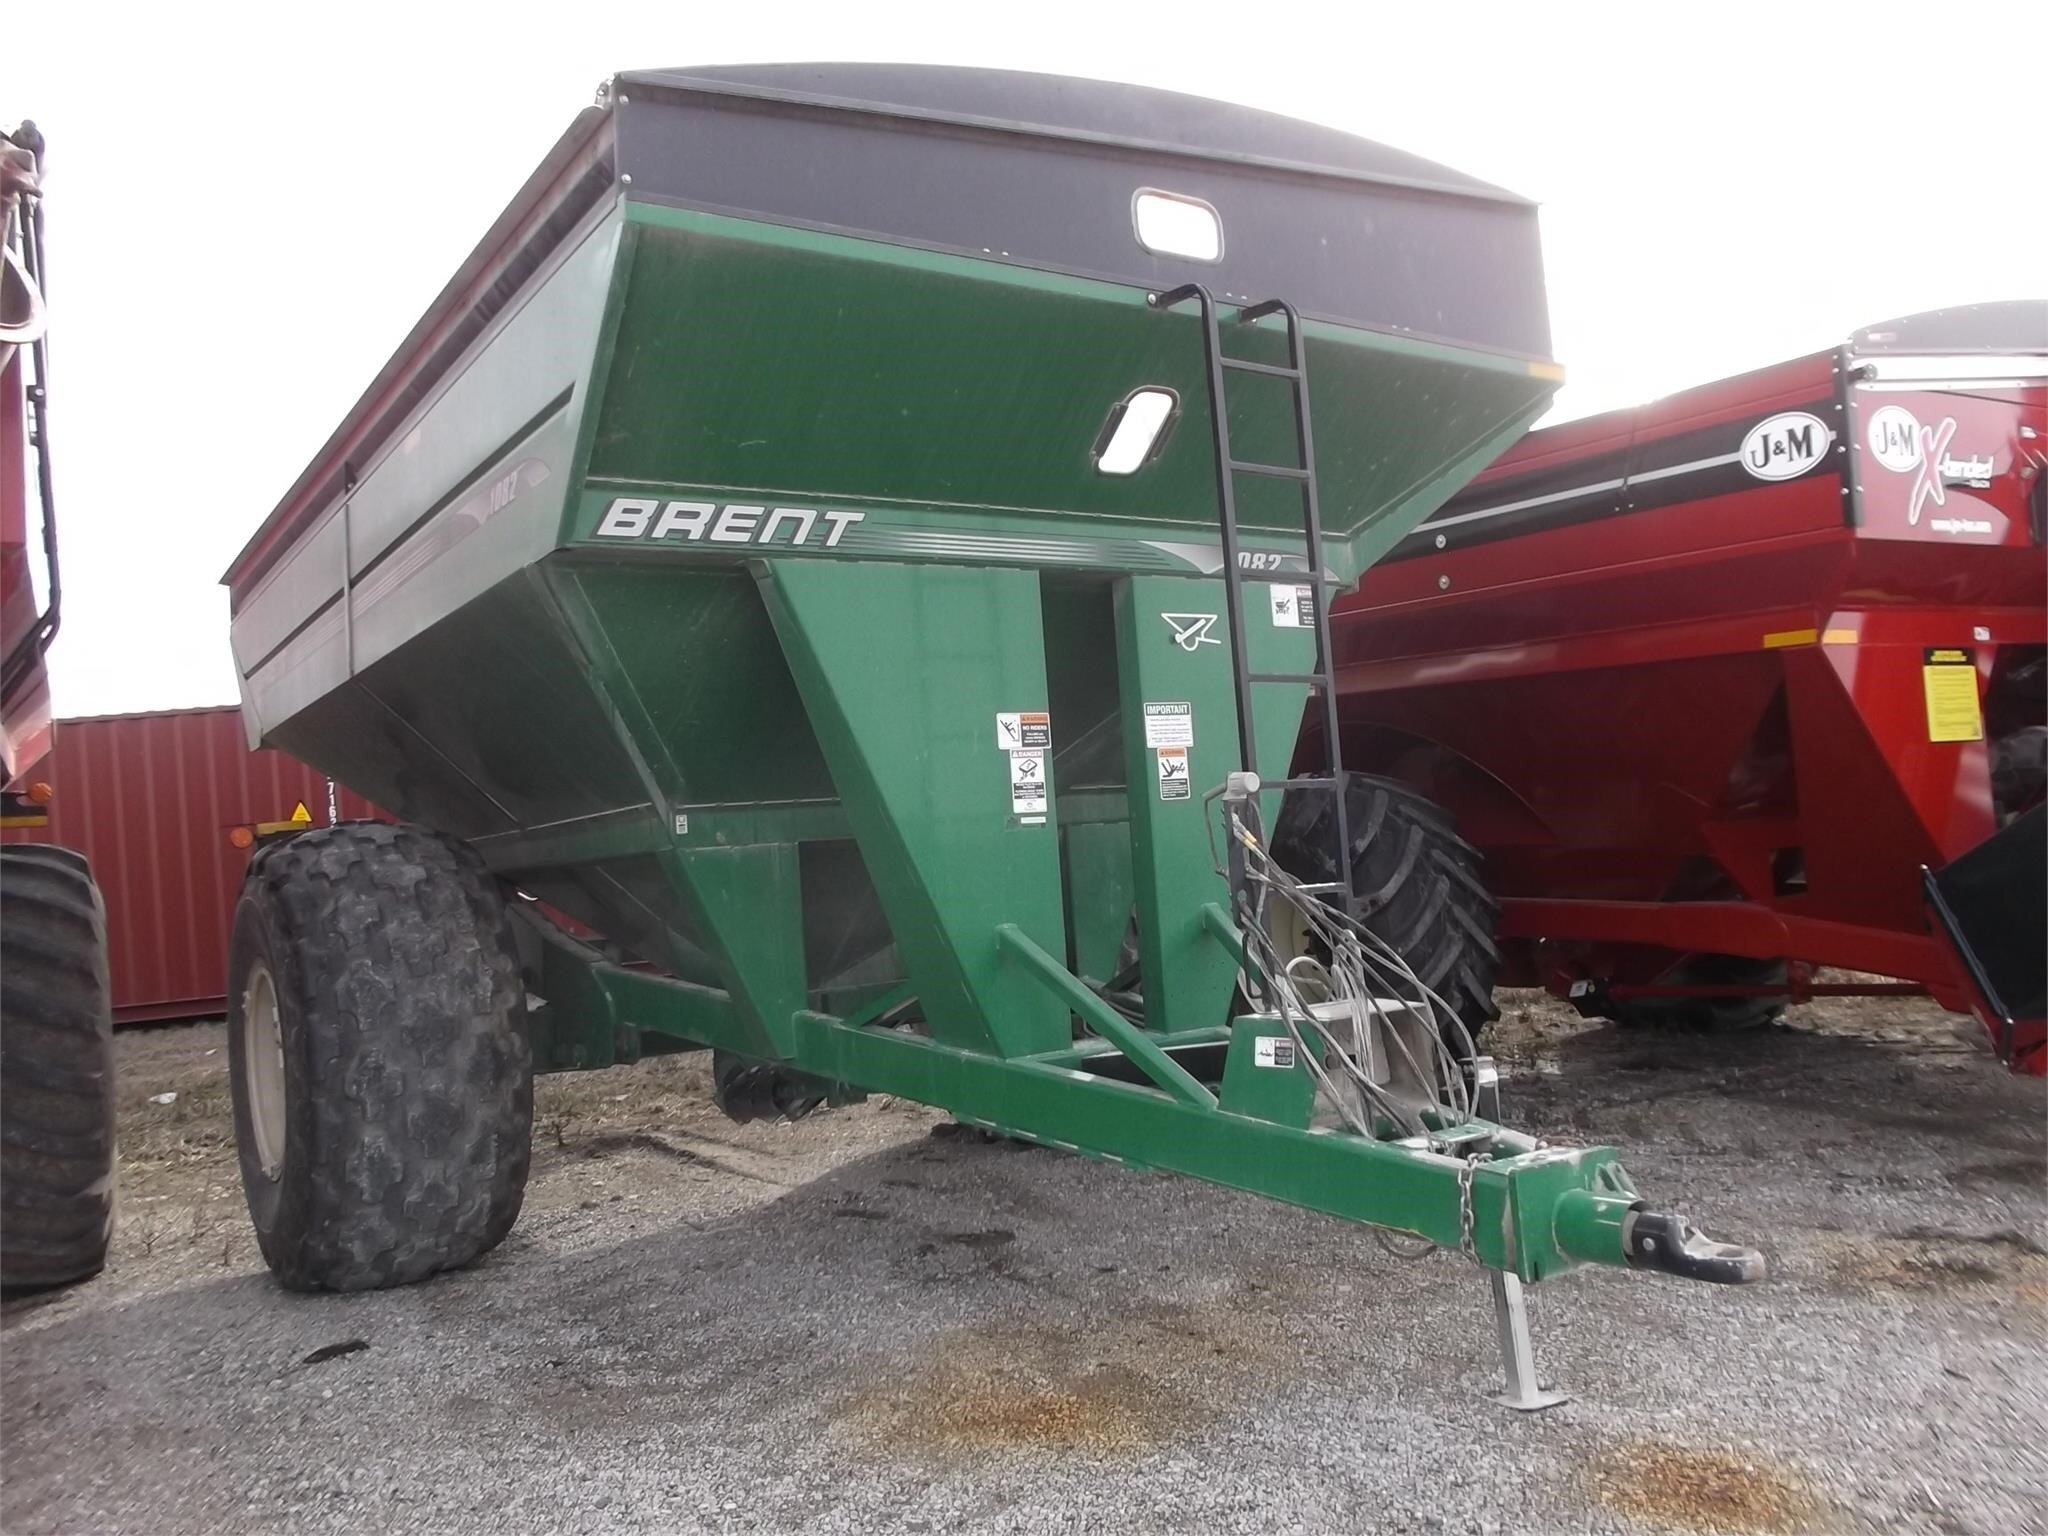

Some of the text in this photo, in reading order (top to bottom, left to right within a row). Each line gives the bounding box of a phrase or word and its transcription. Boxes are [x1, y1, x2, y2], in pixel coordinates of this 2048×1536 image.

[1750, 423, 1815, 469] J&M
[1874, 420, 1915, 456] J&M
[596, 498, 866, 547] BRENT
[1237, 551, 1282, 571] 082
[1147, 705, 1189, 715] IMPORTANT
